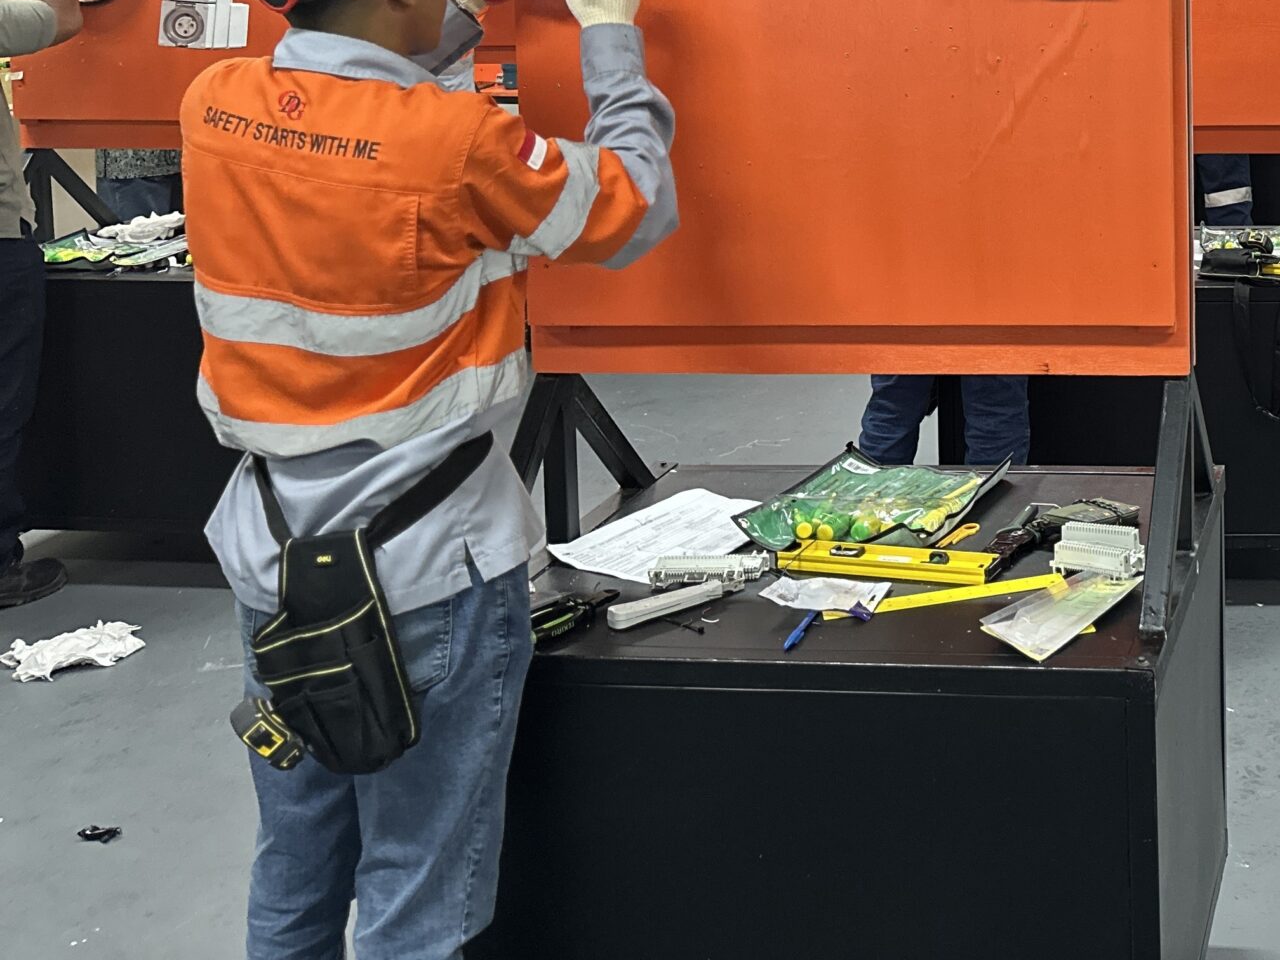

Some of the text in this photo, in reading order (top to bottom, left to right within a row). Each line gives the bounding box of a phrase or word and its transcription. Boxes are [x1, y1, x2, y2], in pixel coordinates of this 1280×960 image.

[203, 106, 382, 161] SAFETY STARTS WITH ME
